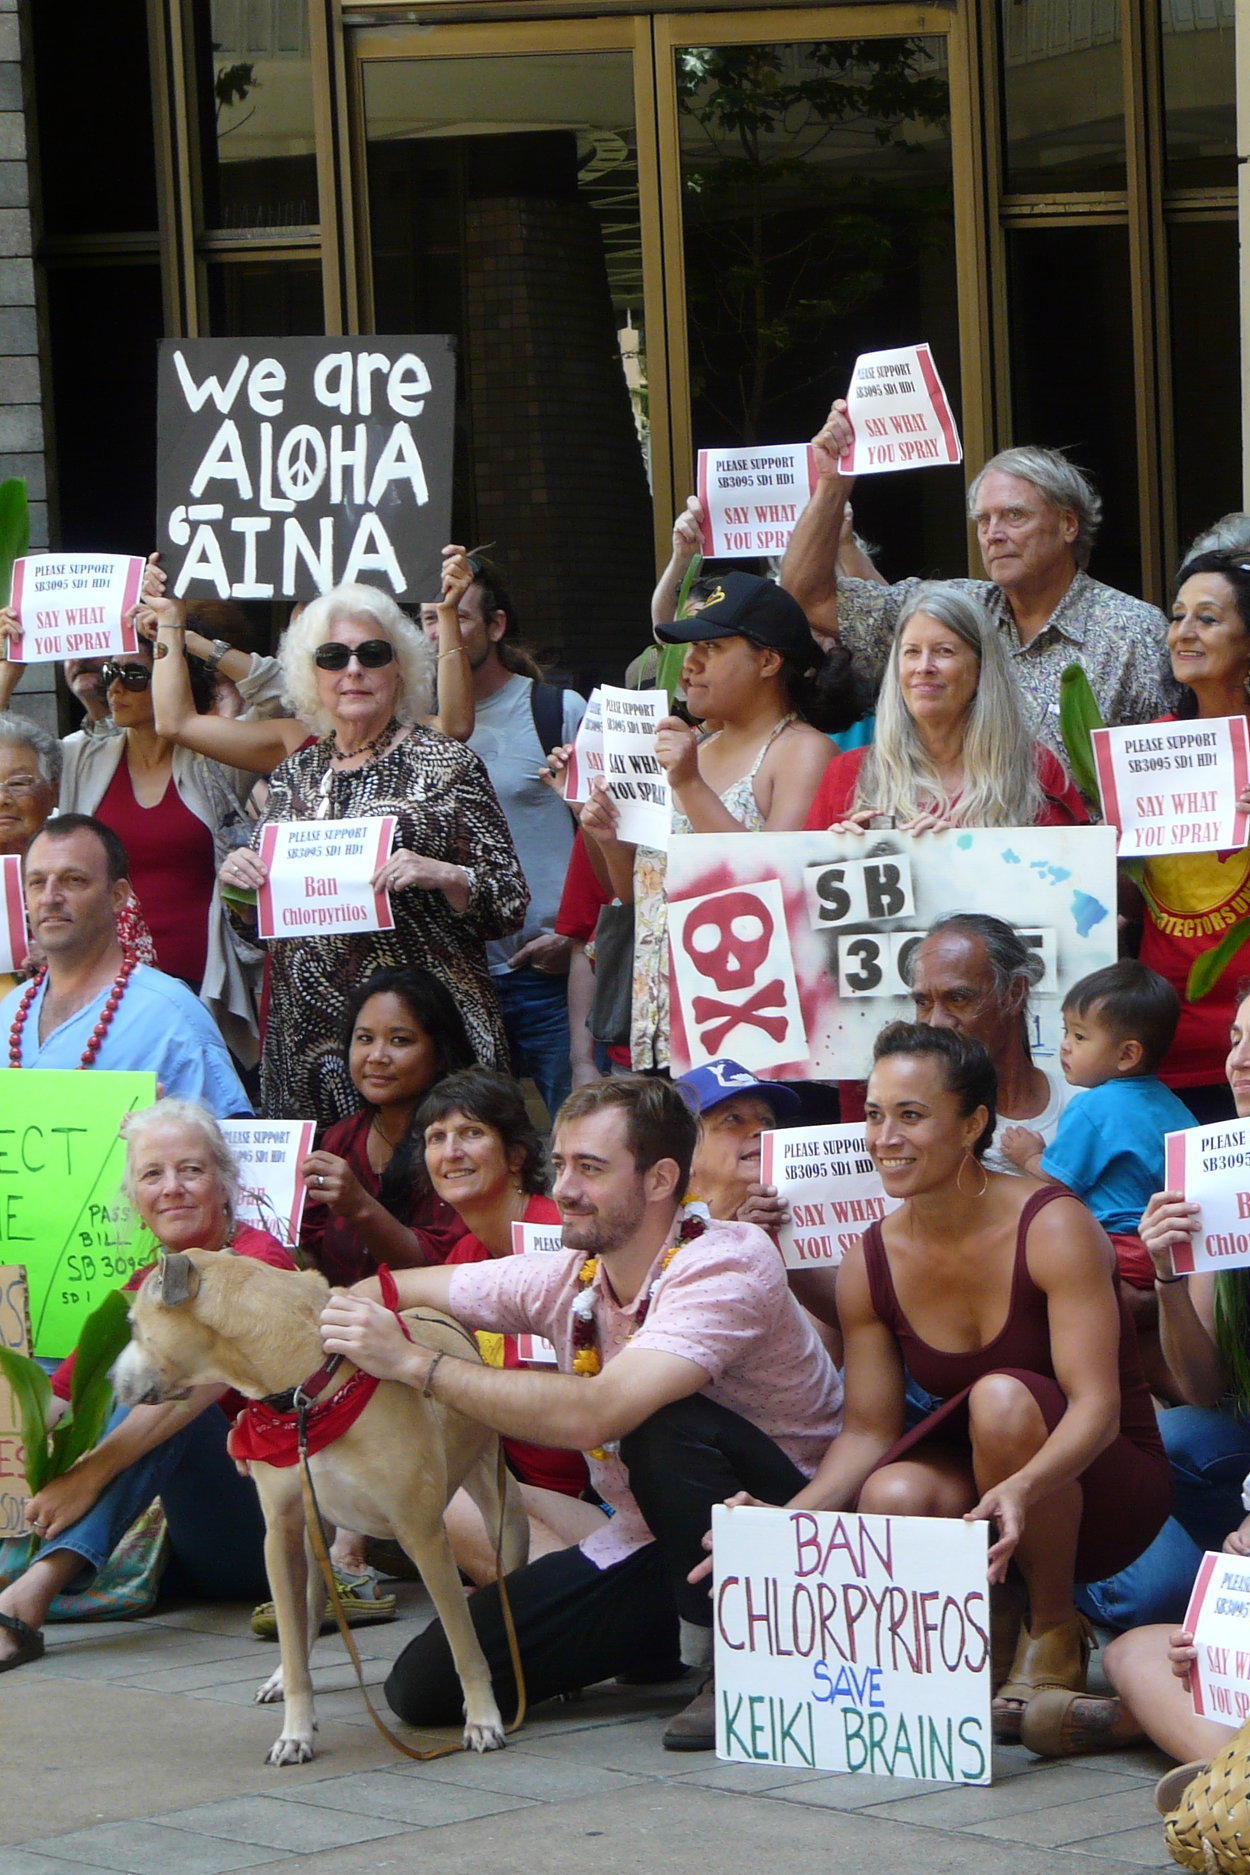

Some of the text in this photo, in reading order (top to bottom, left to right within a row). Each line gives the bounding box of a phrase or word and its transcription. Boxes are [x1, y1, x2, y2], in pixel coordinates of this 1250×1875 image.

[877, 363, 912, 378] SUPPORT
[174, 350, 432, 417] We are
[883, 381, 916, 396] SD1 HD1
[864, 413, 928, 438] SAY WHAT
[867, 438, 940, 465] YOU SPRAY
[190, 419, 429, 512] ALOHA
[716, 456, 795, 472] PLEASE SUPPORT
[718, 474, 795, 488] SB3095 SD1 HD1
[724, 504, 797, 525] SAY WHAT
[724, 532, 752, 551] YOU
[35, 564, 115, 577] PLEASE SUPPORT
[34, 578, 111, 592] SB3095 SD1 HD1
[36, 606, 106, 629] SAY WHAT
[34, 631, 111, 655] YOU SPRAY
[622, 702, 656, 717] SUPPORT
[628, 721, 640, 734] SD1
[1125, 733, 1217, 754] PLEASE SUPPORT
[609, 753, 627, 774] SAY
[1128, 753, 1217, 773] SB3095 SD1 HD1
[609, 781, 636, 800] YOU
[637, 782, 666, 806] SPRAY
[1136, 791, 1218, 817] SAY WHAT
[288, 827, 368, 843] PLEASE SUPPORT
[1135, 821, 1222, 847] YOU SPRAY
[287, 844, 364, 860] SB3095 SD1 HD1
[304, 876, 338, 898] Ban
[816, 862, 906, 922] SB
[282, 904, 368, 926] Chlorpyrifos
[784, 1142, 820, 1158] PLEASE
[1201, 1131, 1246, 1152] PLEASE
[785, 1161, 851, 1180] SB3095 SD1
[88, 1204, 130, 1228] PASS
[793, 1197, 886, 1228] SAY WHAT
[79, 1232, 132, 1247] BILL
[793, 1235, 832, 1260] YOU
[790, 1512, 893, 1582] BAN
[718, 1575, 989, 1674] CHLORPYRIFOS
[1207, 1645, 1230, 1676] SAY
[811, 1659, 885, 1708] SAVE
[1208, 1684, 1232, 1715] YOU
[723, 1690, 986, 1781] KEIKI BRAINS
